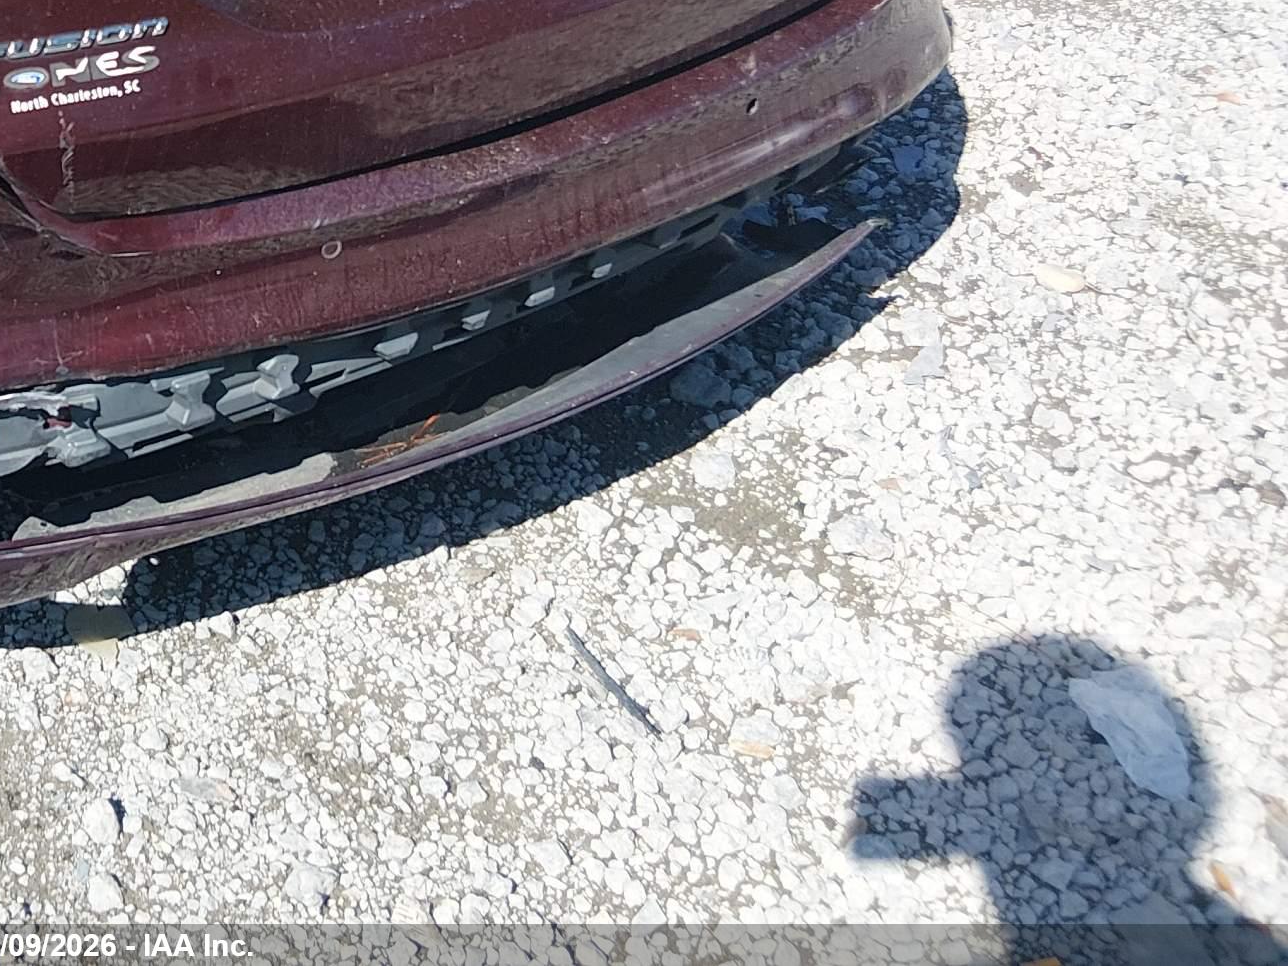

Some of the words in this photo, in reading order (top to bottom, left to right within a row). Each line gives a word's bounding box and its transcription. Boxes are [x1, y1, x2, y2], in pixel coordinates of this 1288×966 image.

[10, 95, 49, 114] North
[51, 85, 123, 106] Charleston,
[123, 78, 141, 94] SC
